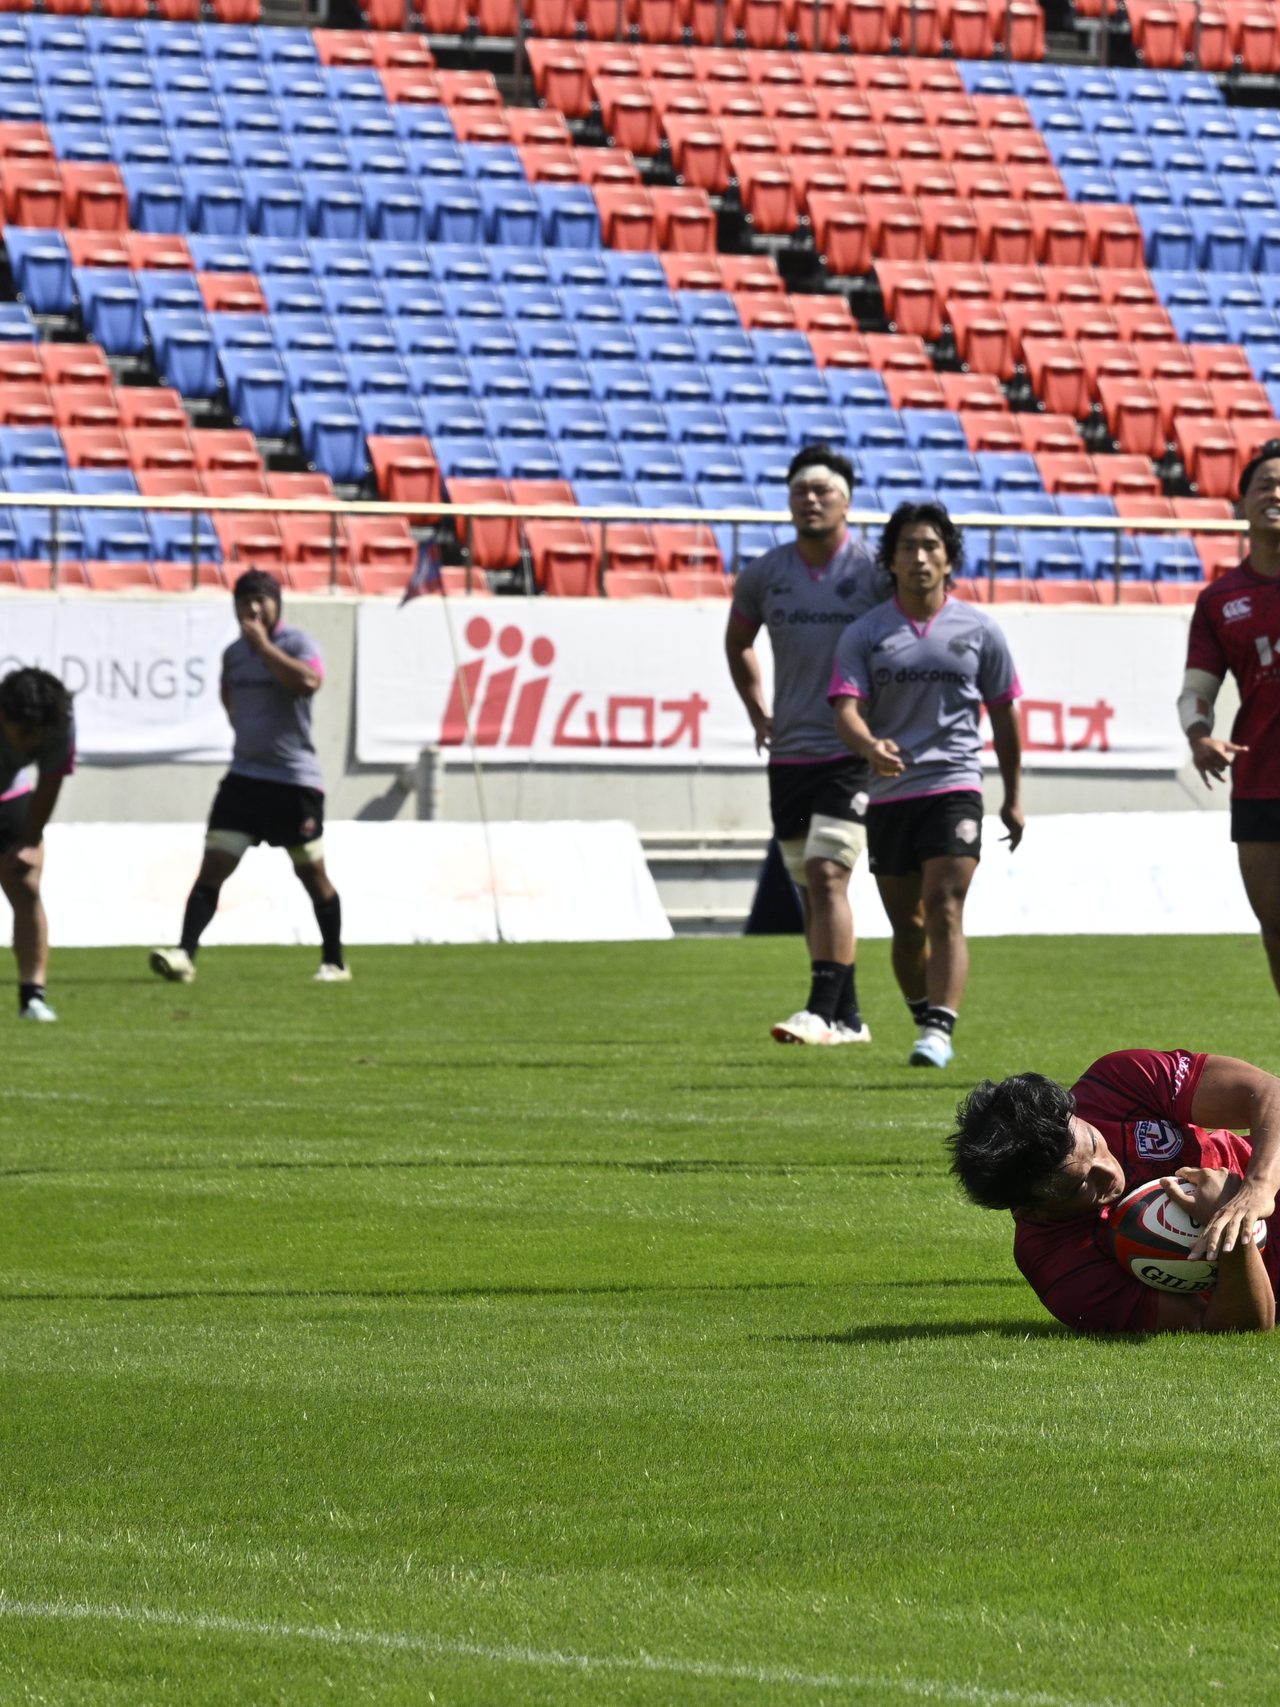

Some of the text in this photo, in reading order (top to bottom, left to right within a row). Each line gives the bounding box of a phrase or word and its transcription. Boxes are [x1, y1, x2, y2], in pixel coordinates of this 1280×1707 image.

[0, 655, 206, 700] DINGS
[895, 667, 971, 684] docomo
[552, 691, 709, 749] ムロオ
